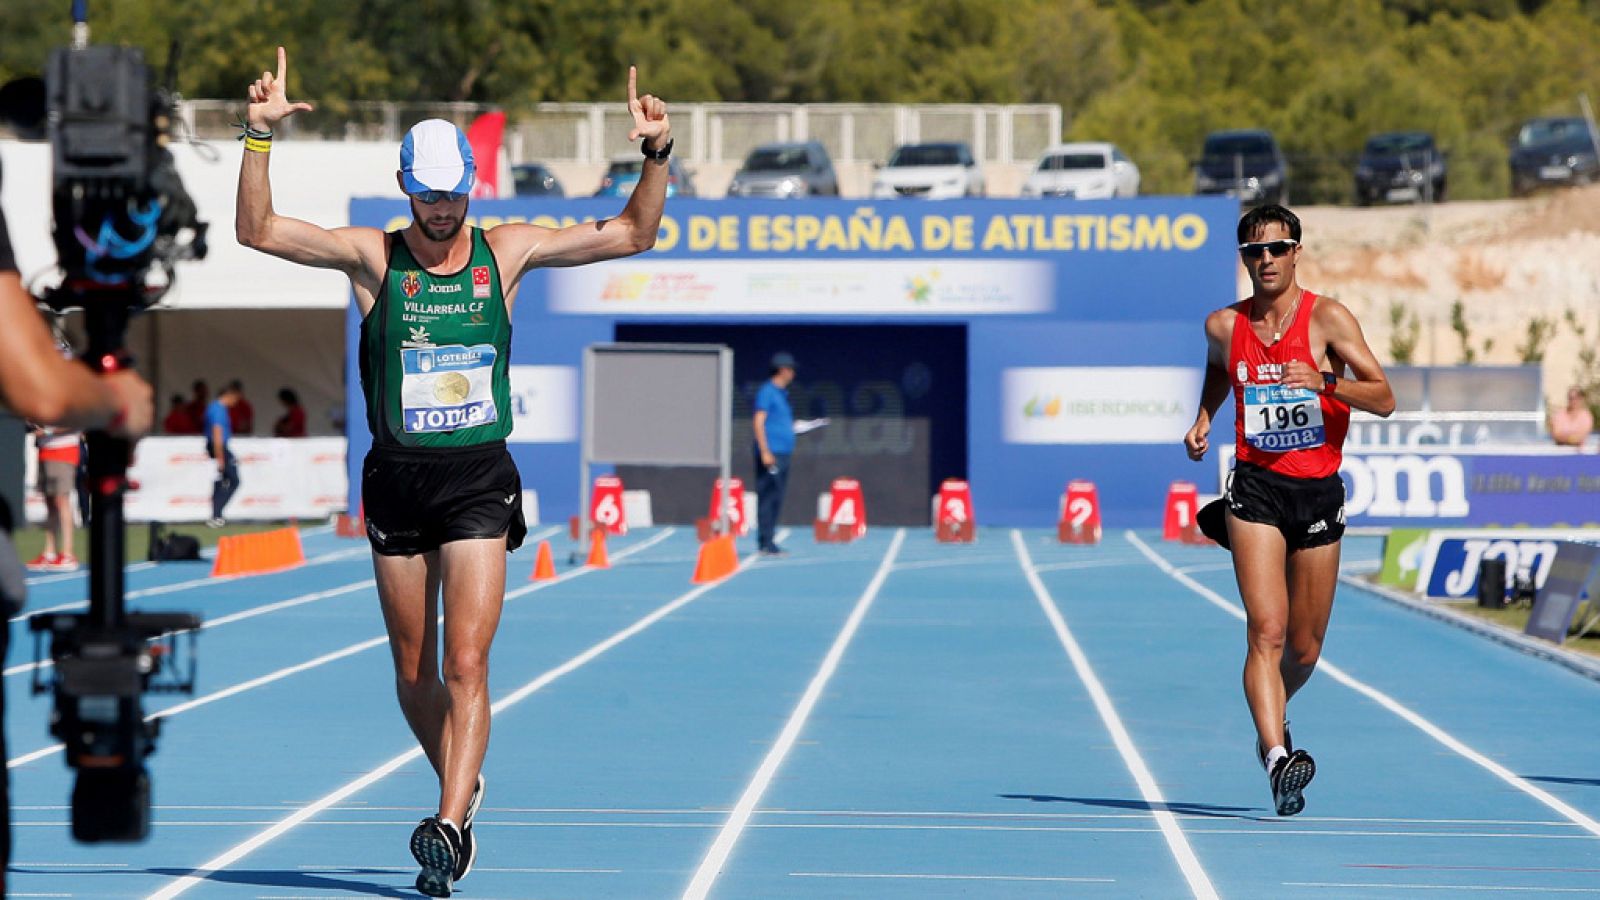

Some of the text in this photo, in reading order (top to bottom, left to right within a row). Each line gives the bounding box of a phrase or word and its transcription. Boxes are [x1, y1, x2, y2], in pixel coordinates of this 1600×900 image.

[689, 215, 739, 250] DE
[747, 207, 914, 250] ESPAÑA
[922, 215, 974, 250] DE
[982, 214, 1208, 250] ATLETISMO
[428, 283, 462, 293] Joma
[404, 301, 468, 315] VILLARREAL
[412, 406, 486, 431] Joma
[1259, 403, 1309, 430] 196
[1254, 429, 1317, 449] Joma
[595, 494, 620, 525] 6
[832, 499, 857, 525] 4
[1069, 498, 1093, 528] 2
[1174, 501, 1190, 527] 1
